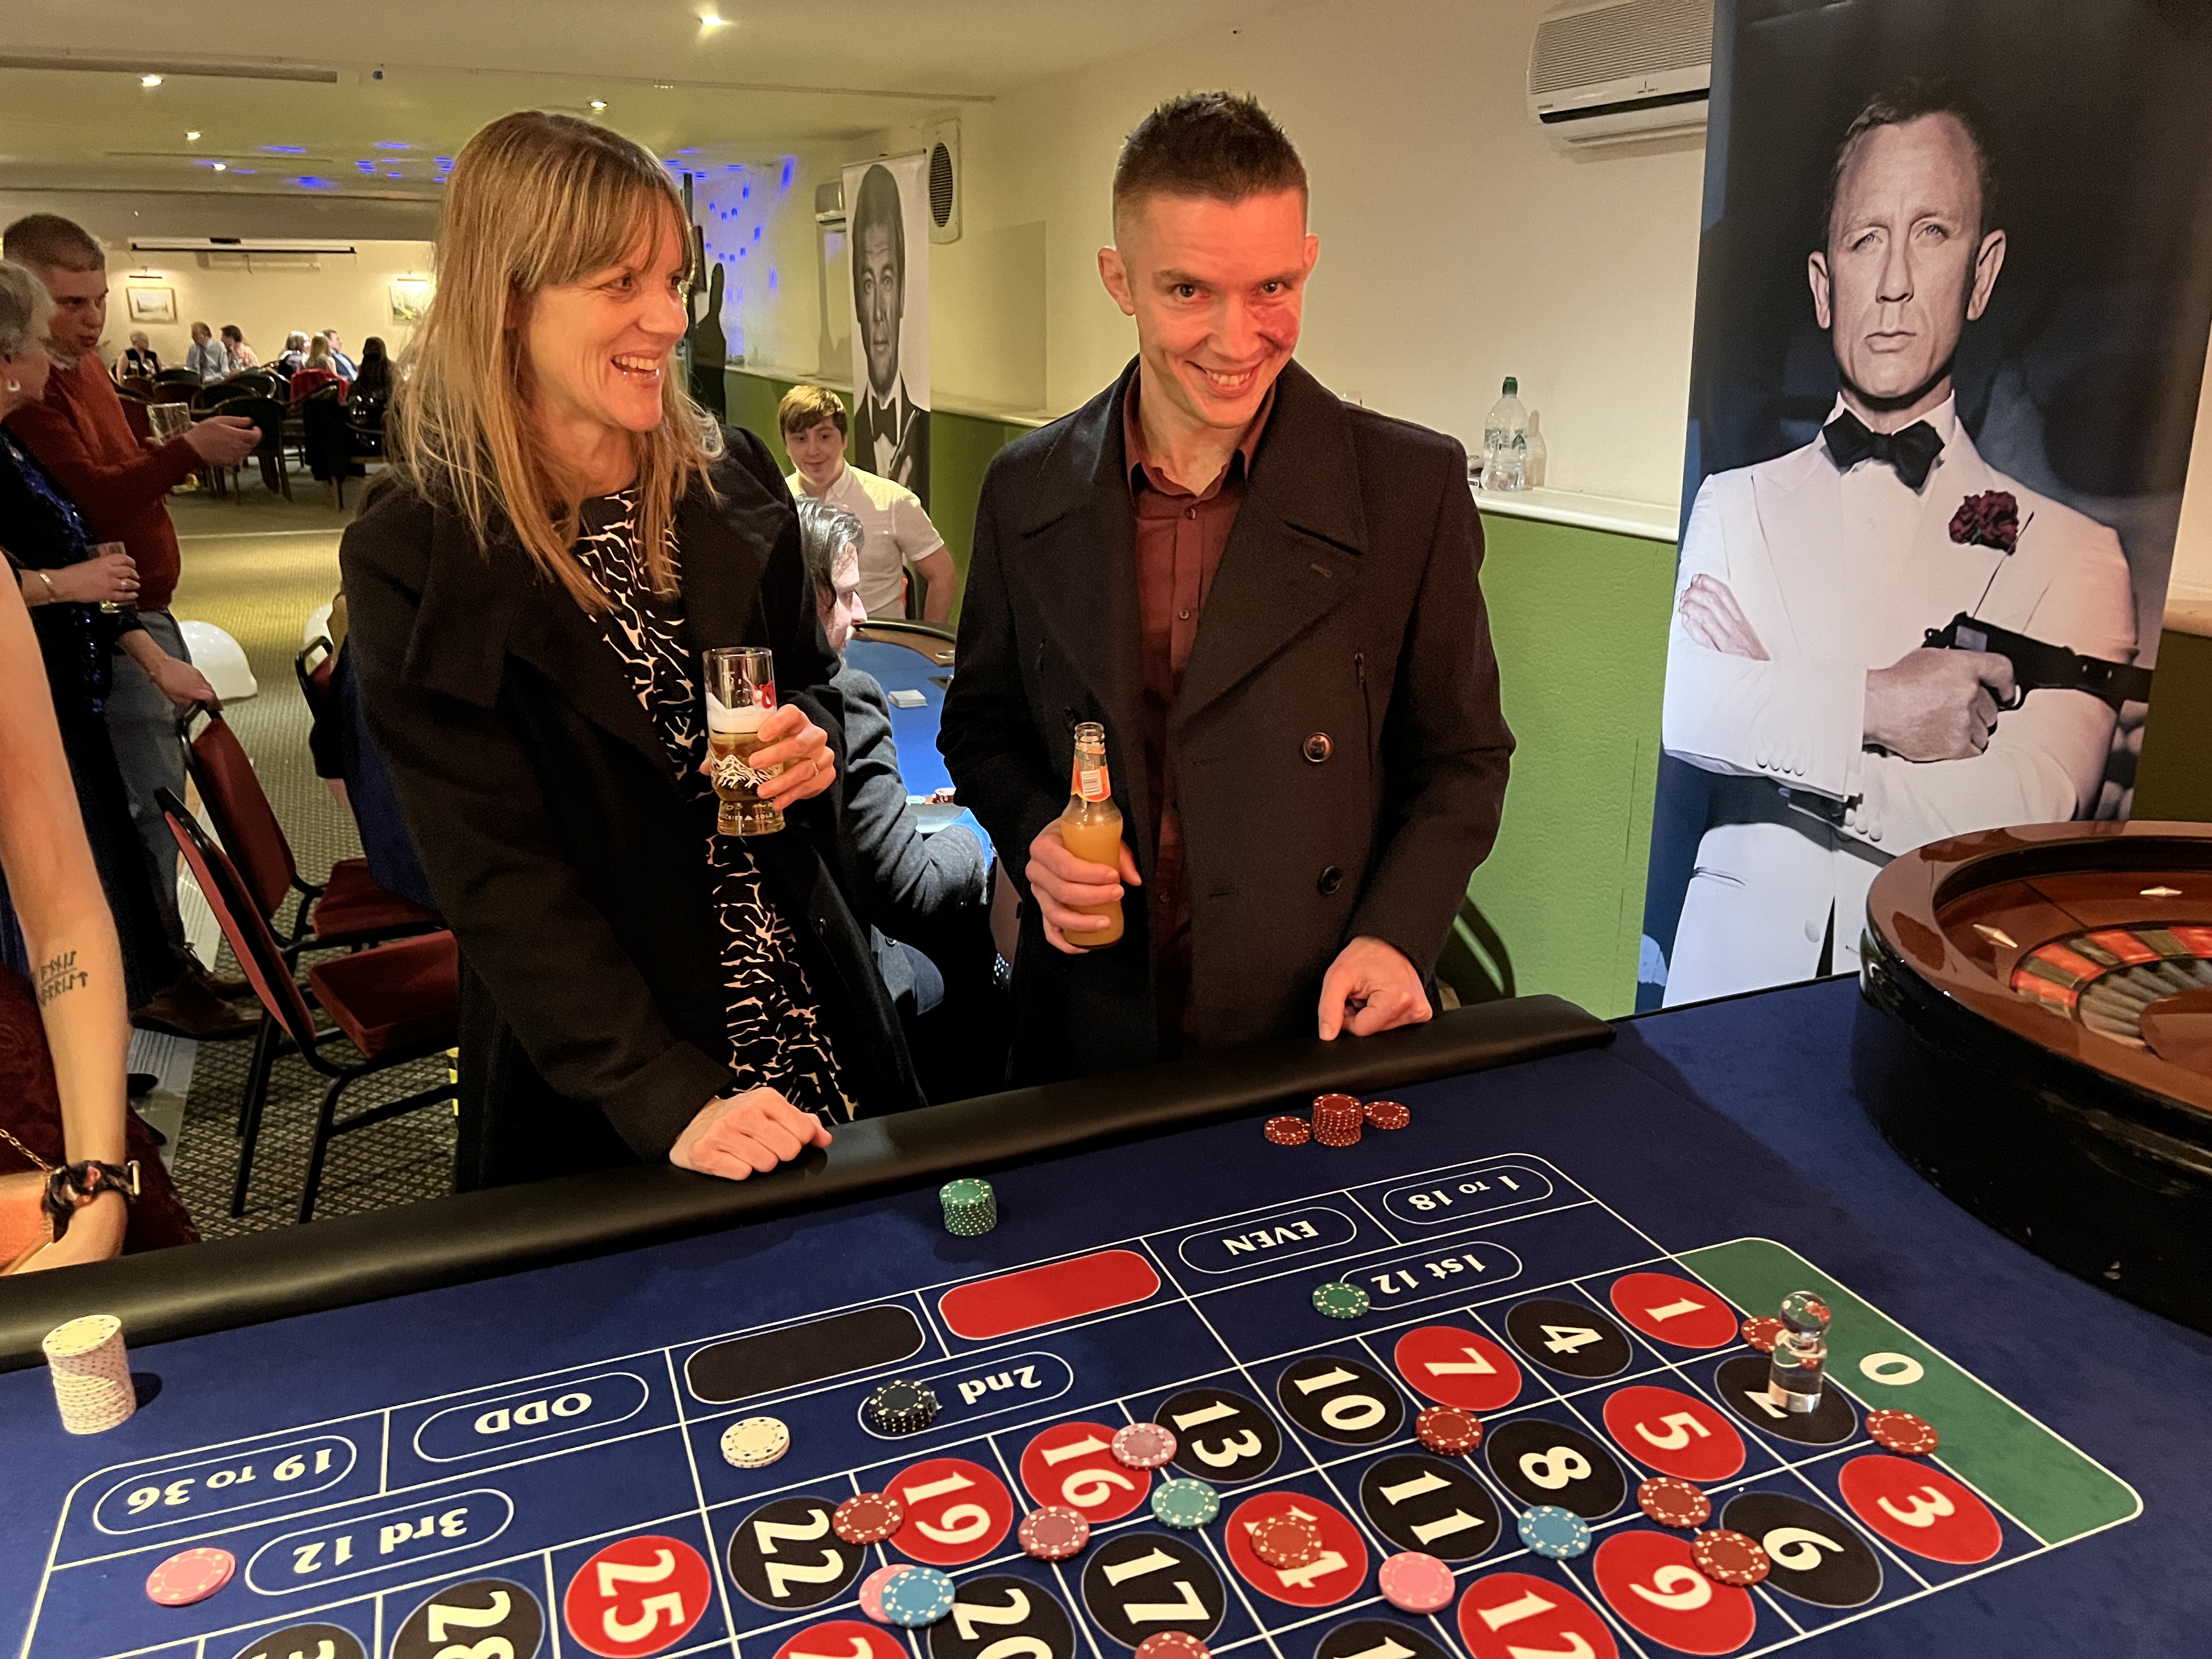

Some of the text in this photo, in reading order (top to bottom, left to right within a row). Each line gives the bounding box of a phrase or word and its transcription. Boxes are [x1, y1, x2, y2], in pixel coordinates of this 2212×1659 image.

[1408, 1190, 1453, 1211] 18
[1498, 1175, 1521, 1192] 1
[1222, 1220, 1319, 1256] EVEN
[1370, 1254, 1486, 1294] 1st 12
[1645, 1297, 1706, 1322] 1
[1539, 1324, 1603, 1353] 4
[1424, 1347, 1497, 1376] 7
[1859, 1352, 1925, 1386] 0
[957, 1364, 1042, 1406] 2nd
[1293, 1366, 1386, 1430] 10
[474, 1392, 592, 1434] ODD
[1171, 1400, 1262, 1468] 13
[1634, 1412, 1711, 1450] 5
[273, 1448, 332, 1482] 19
[1041, 1434, 1135, 1507] 16
[1519, 1446, 1592, 1489] 8
[127, 1477, 189, 1515] 36
[902, 1471, 991, 1544] 19
[1379, 1470, 1485, 1545] 11
[1877, 1486, 1955, 1528] 3
[292, 1507, 468, 1575] 3rd 12
[753, 1508, 844, 1598] 22
[1762, 1527, 1845, 1571] 6
[597, 1548, 686, 1643] 25
[1103, 1547, 1211, 1624] 17
[1629, 1564, 1712, 1610] 9
